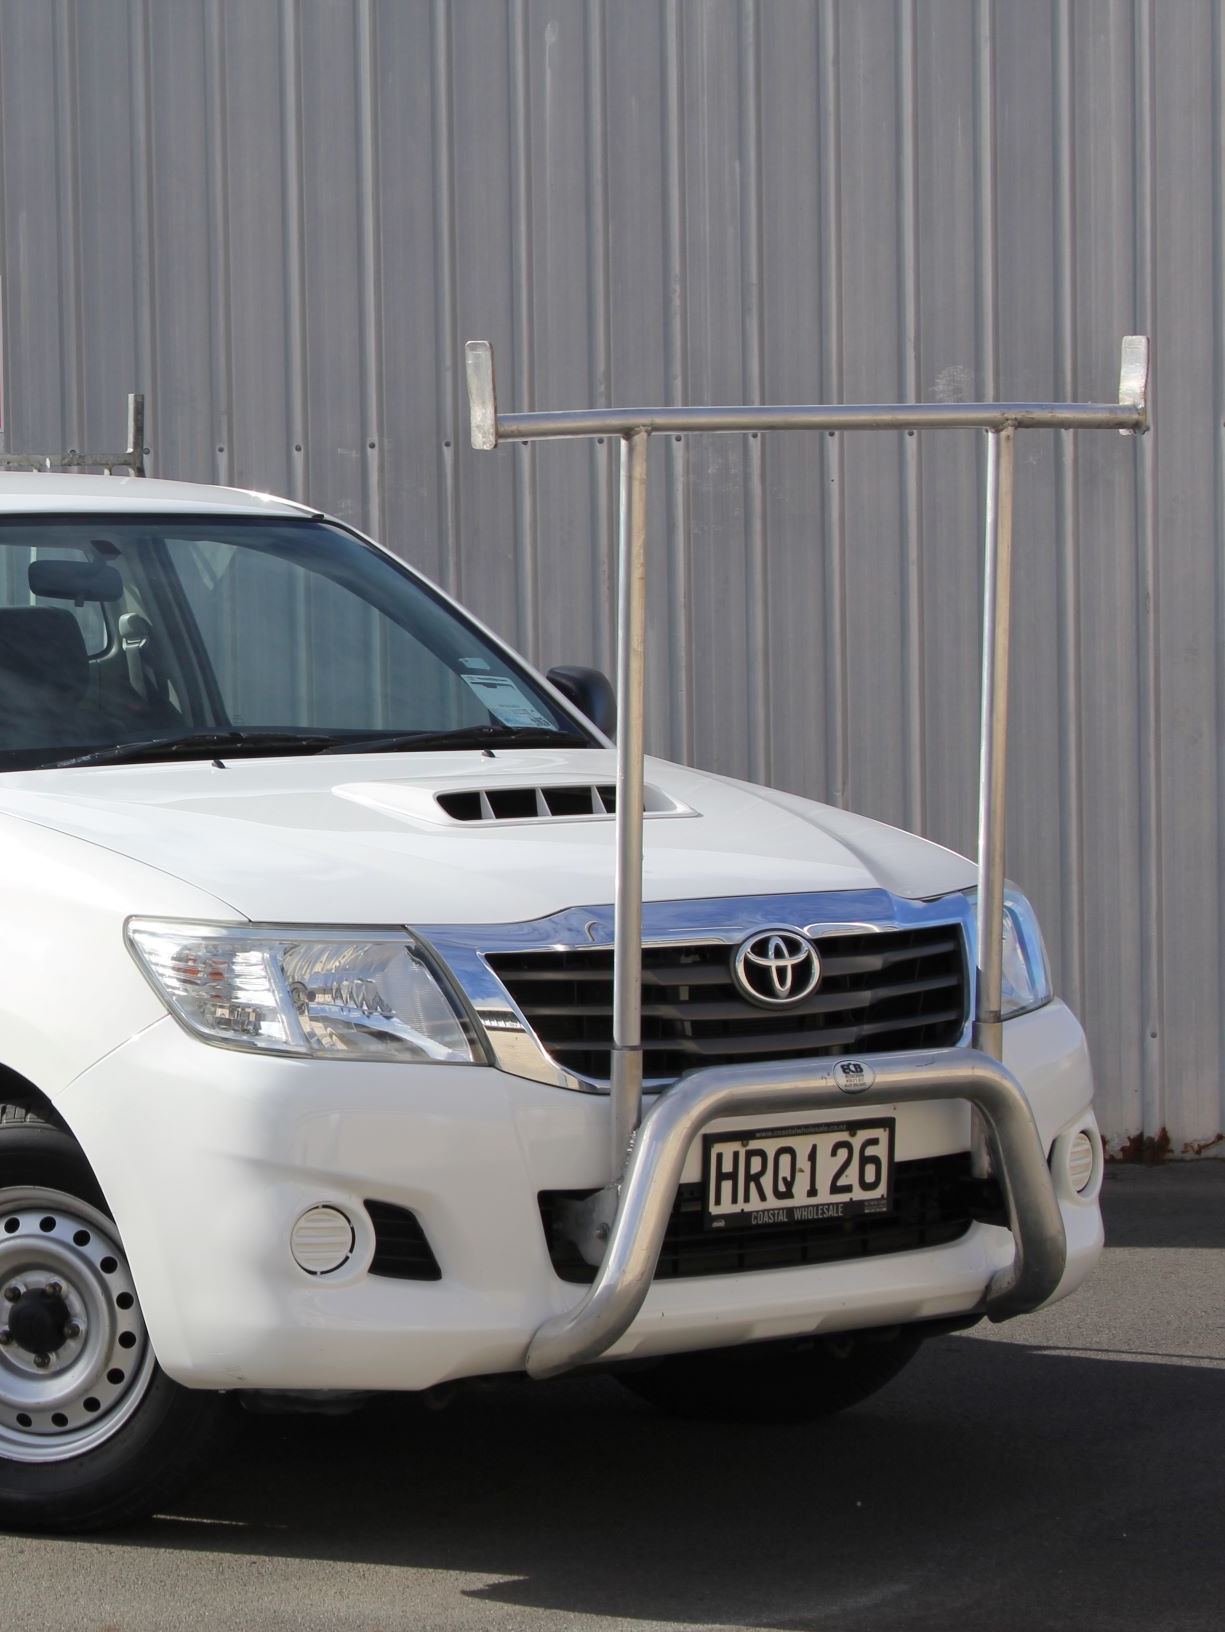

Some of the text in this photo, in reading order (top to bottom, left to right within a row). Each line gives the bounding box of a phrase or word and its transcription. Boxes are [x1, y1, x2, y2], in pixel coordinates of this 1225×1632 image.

[714, 1137, 883, 1207] HRQ126
[751, 1208, 788, 1225] COASTAL
[793, 1203, 844, 1221] WHOLESALE
